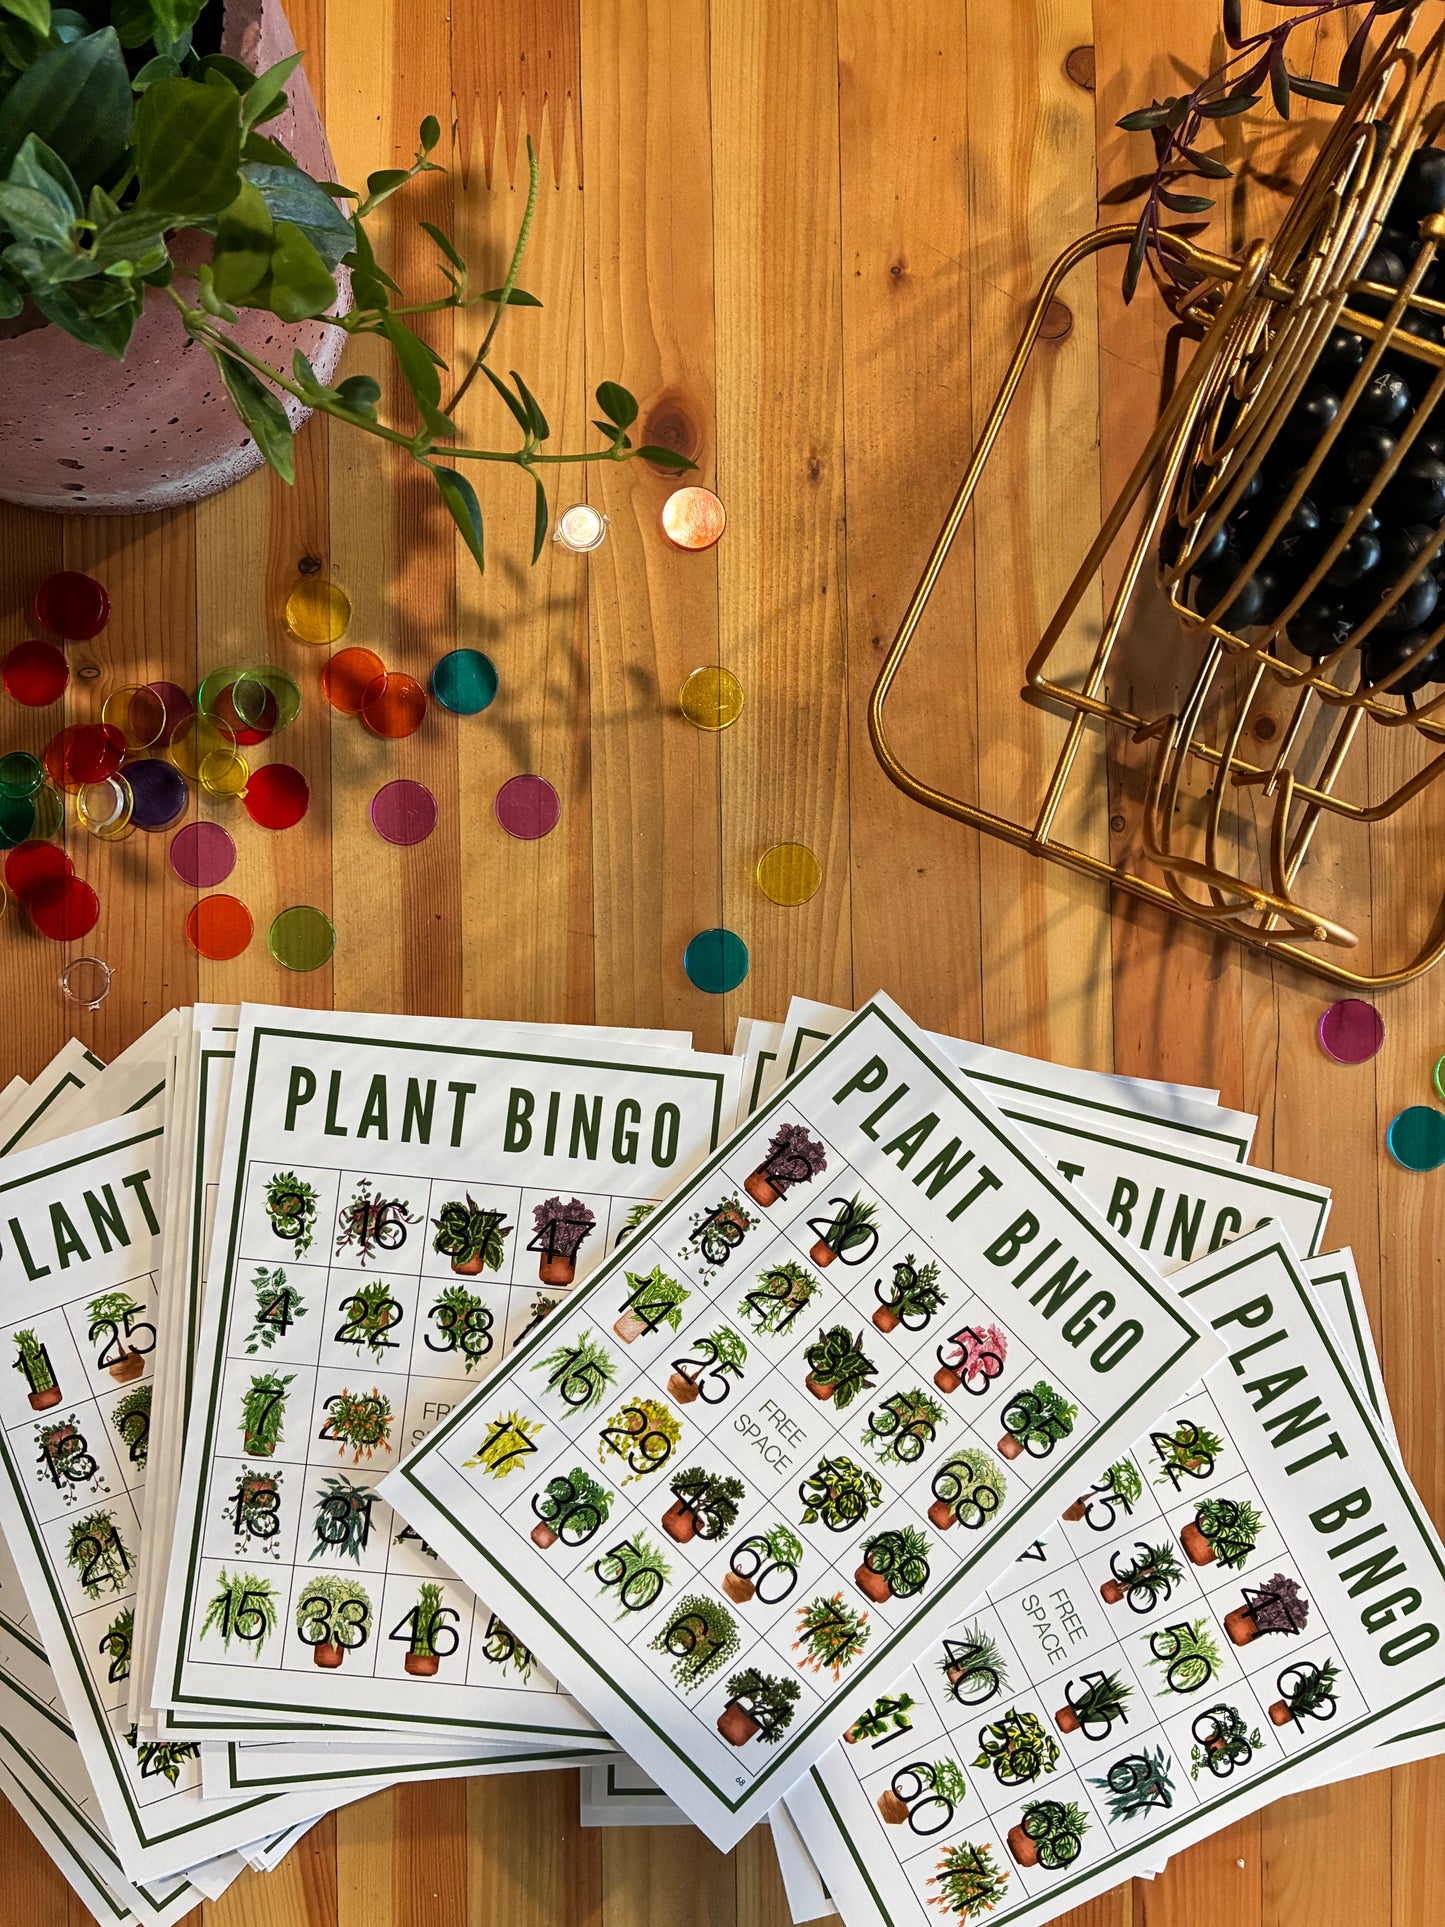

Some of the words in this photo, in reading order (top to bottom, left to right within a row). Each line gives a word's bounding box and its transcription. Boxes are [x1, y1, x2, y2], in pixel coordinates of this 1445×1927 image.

[284, 1066, 476, 1148] PLANT
[504, 1087, 681, 1168] BINGO
[758, 1141, 812, 1201] 12
[0, 1169, 160, 1281] LANT
[271, 1193, 305, 1240] 3
[359, 1200, 407, 1250] 16
[435, 1206, 507, 1257] 37
[527, 1219, 596, 1266] 47
[689, 1206, 744, 1264] 13
[807, 1197, 878, 1266] 20
[832, 1054, 1004, 1223] PLANT
[983, 1209, 1144, 1374] BINGO
[1106, 1176, 1274, 1262] BING
[260, 1289, 293, 1337] 4
[334, 1296, 403, 1348] 22
[424, 1304, 494, 1355] 38
[618, 1278, 676, 1336] 14
[745, 1271, 809, 1332] 21
[874, 1263, 946, 1332] 35
[12, 1343, 58, 1395] 11
[88, 1305, 157, 1370] 25
[807, 1331, 879, 1392] 37
[937, 1326, 1004, 1396] 53
[548, 1349, 608, 1405] 15
[671, 1338, 745, 1405] 25
[254, 1388, 284, 1436] 7
[599, 1407, 671, 1474] 29
[733, 1413, 793, 1475] SPACE
[759, 1398, 807, 1448] FREE
[868, 1392, 936, 1463] 56
[1001, 1392, 1071, 1459] 65
[36, 1433, 98, 1489] 13
[477, 1420, 538, 1470] 17
[1150, 1420, 1215, 1492] 22
[531, 1476, 601, 1547] 30
[670, 1481, 740, 1541] 45
[798, 1464, 867, 1533] 59
[931, 1460, 999, 1530] 68
[1210, 1294, 1349, 1476] PLANT
[1308, 1486, 1440, 1667] BINGO
[228, 1488, 281, 1539] 13
[317, 1496, 373, 1548] 31
[1195, 1498, 1256, 1569] 34
[73, 1526, 130, 1588] 21
[594, 1540, 664, 1611] 50
[730, 1535, 798, 1605] 60
[864, 1530, 931, 1599] 69
[1110, 1542, 1171, 1614] 36
[216, 1589, 269, 1640] 15
[297, 1597, 368, 1649] 33
[389, 1605, 461, 1657] 46
[665, 1612, 727, 1676] 61
[799, 1601, 857, 1667] 71
[1021, 1594, 1067, 1666] SPACE
[1048, 1588, 1088, 1644] FREE
[1241, 1588, 1300, 1639] 47
[941, 1638, 1000, 1706] 40
[1150, 1622, 1212, 1693] 50
[724, 1668, 794, 1743] 74
[860, 1698, 914, 1751] 41
[1065, 1671, 1129, 1741] 55
[1276, 1660, 1337, 1735] 62
[735, 1776, 746, 1787] 68
[978, 1714, 1040, 1787] 59
[891, 1761, 954, 1835] 60
[1107, 1754, 1173, 1813] 67
[1021, 1800, 1081, 1870] 69
[936, 1847, 994, 1912] 71
